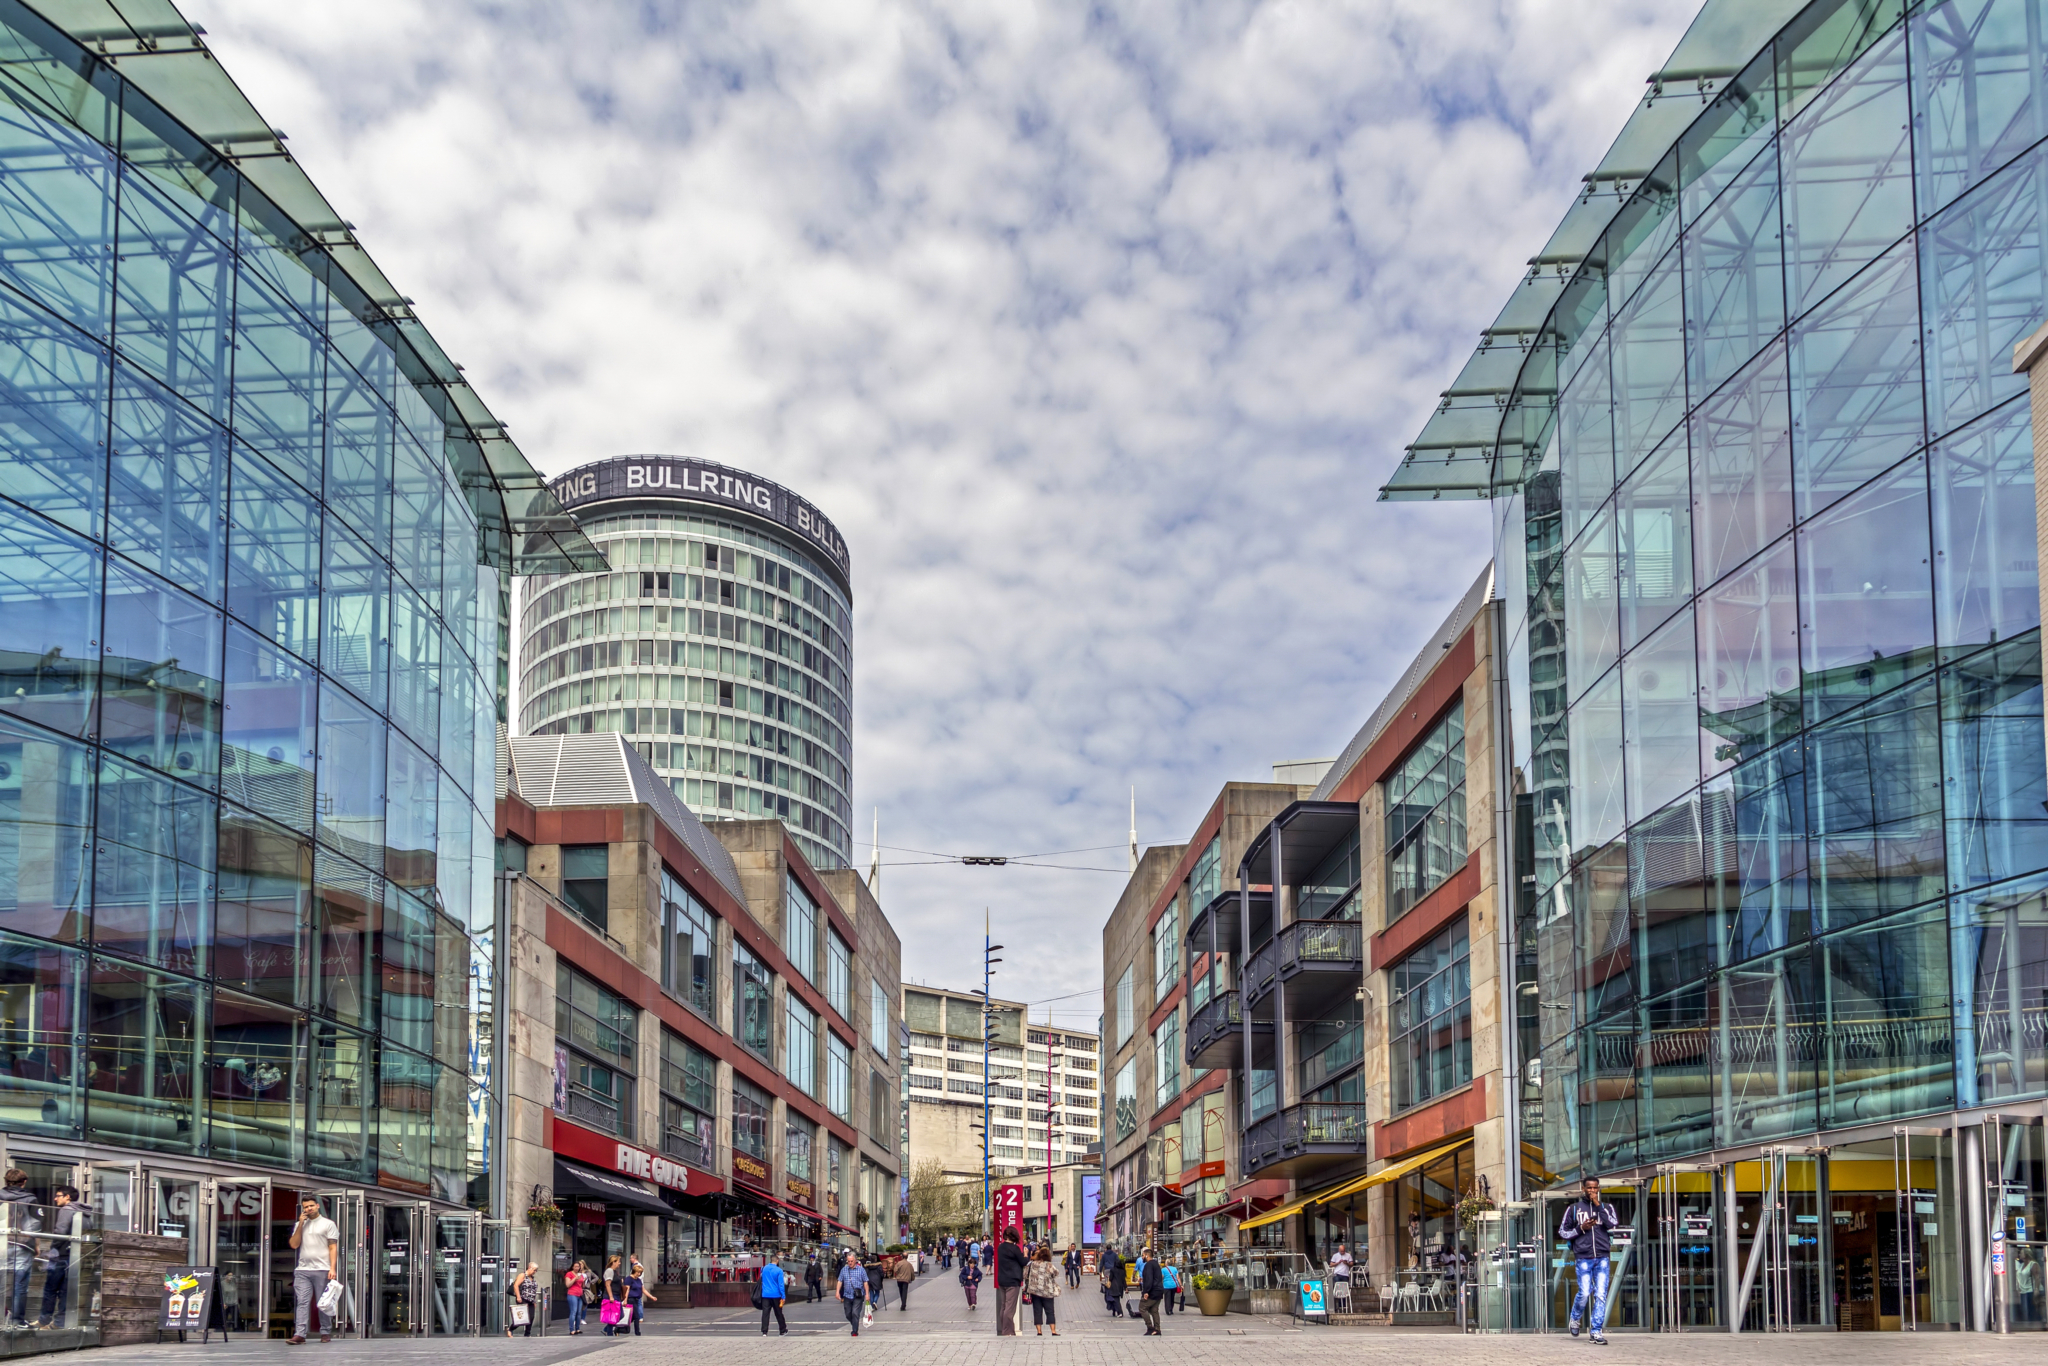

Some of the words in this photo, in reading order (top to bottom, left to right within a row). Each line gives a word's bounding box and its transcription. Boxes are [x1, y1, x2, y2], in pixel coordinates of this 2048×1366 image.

[626, 465, 772, 512] BULLRING
[243, 949, 279, 973] Café
[283, 948, 353, 967] Paserie
[616, 1143, 651, 1179] FIVE
[651, 1156, 688, 1191] GUYS
[169, 1191, 262, 1216] GYS
[995, 1193, 1003, 1211] 2
[1006, 1188, 1018, 1206] 2
[591, 1203, 606, 1213] GUYS
[1008, 1210, 1016, 1226] BUL
